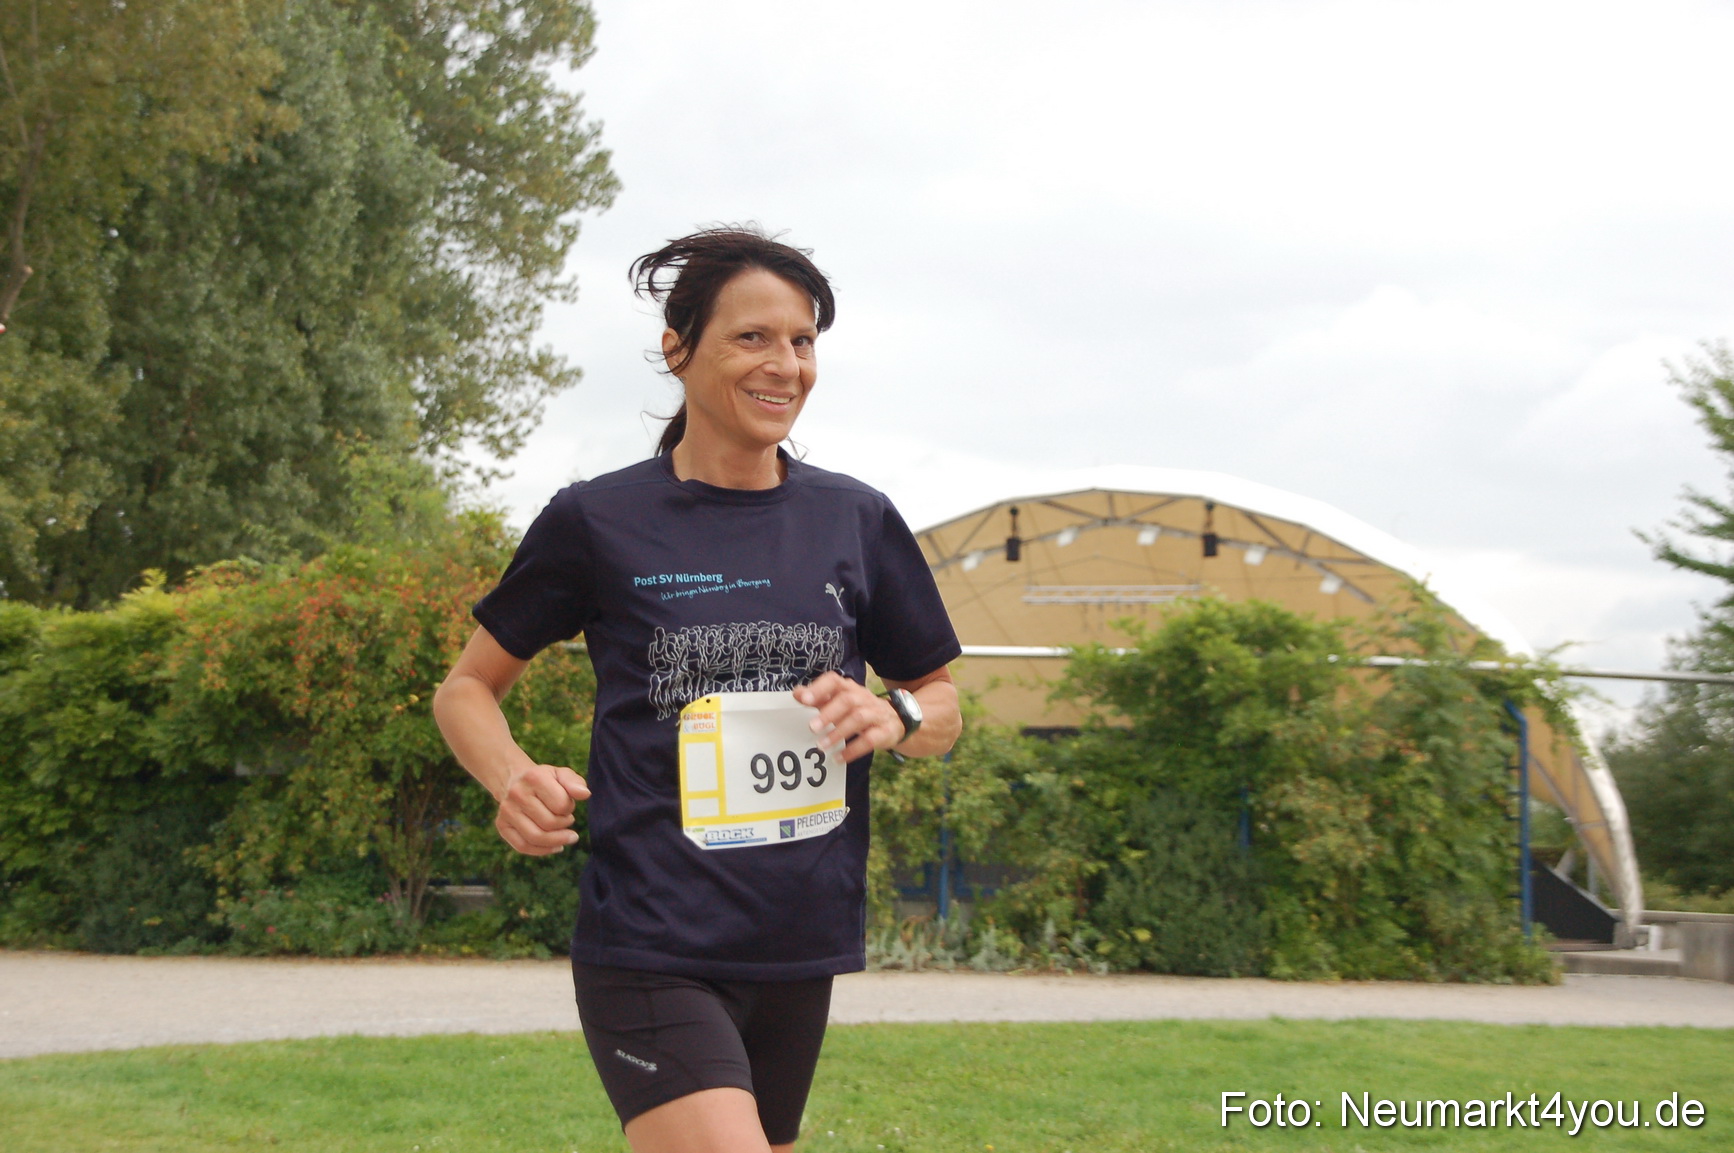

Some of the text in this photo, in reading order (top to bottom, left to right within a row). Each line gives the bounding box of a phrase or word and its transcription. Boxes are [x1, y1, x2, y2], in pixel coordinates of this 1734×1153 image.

[634, 573, 723, 587] Post SV Nürnberg
[750, 748, 827, 794] 993
